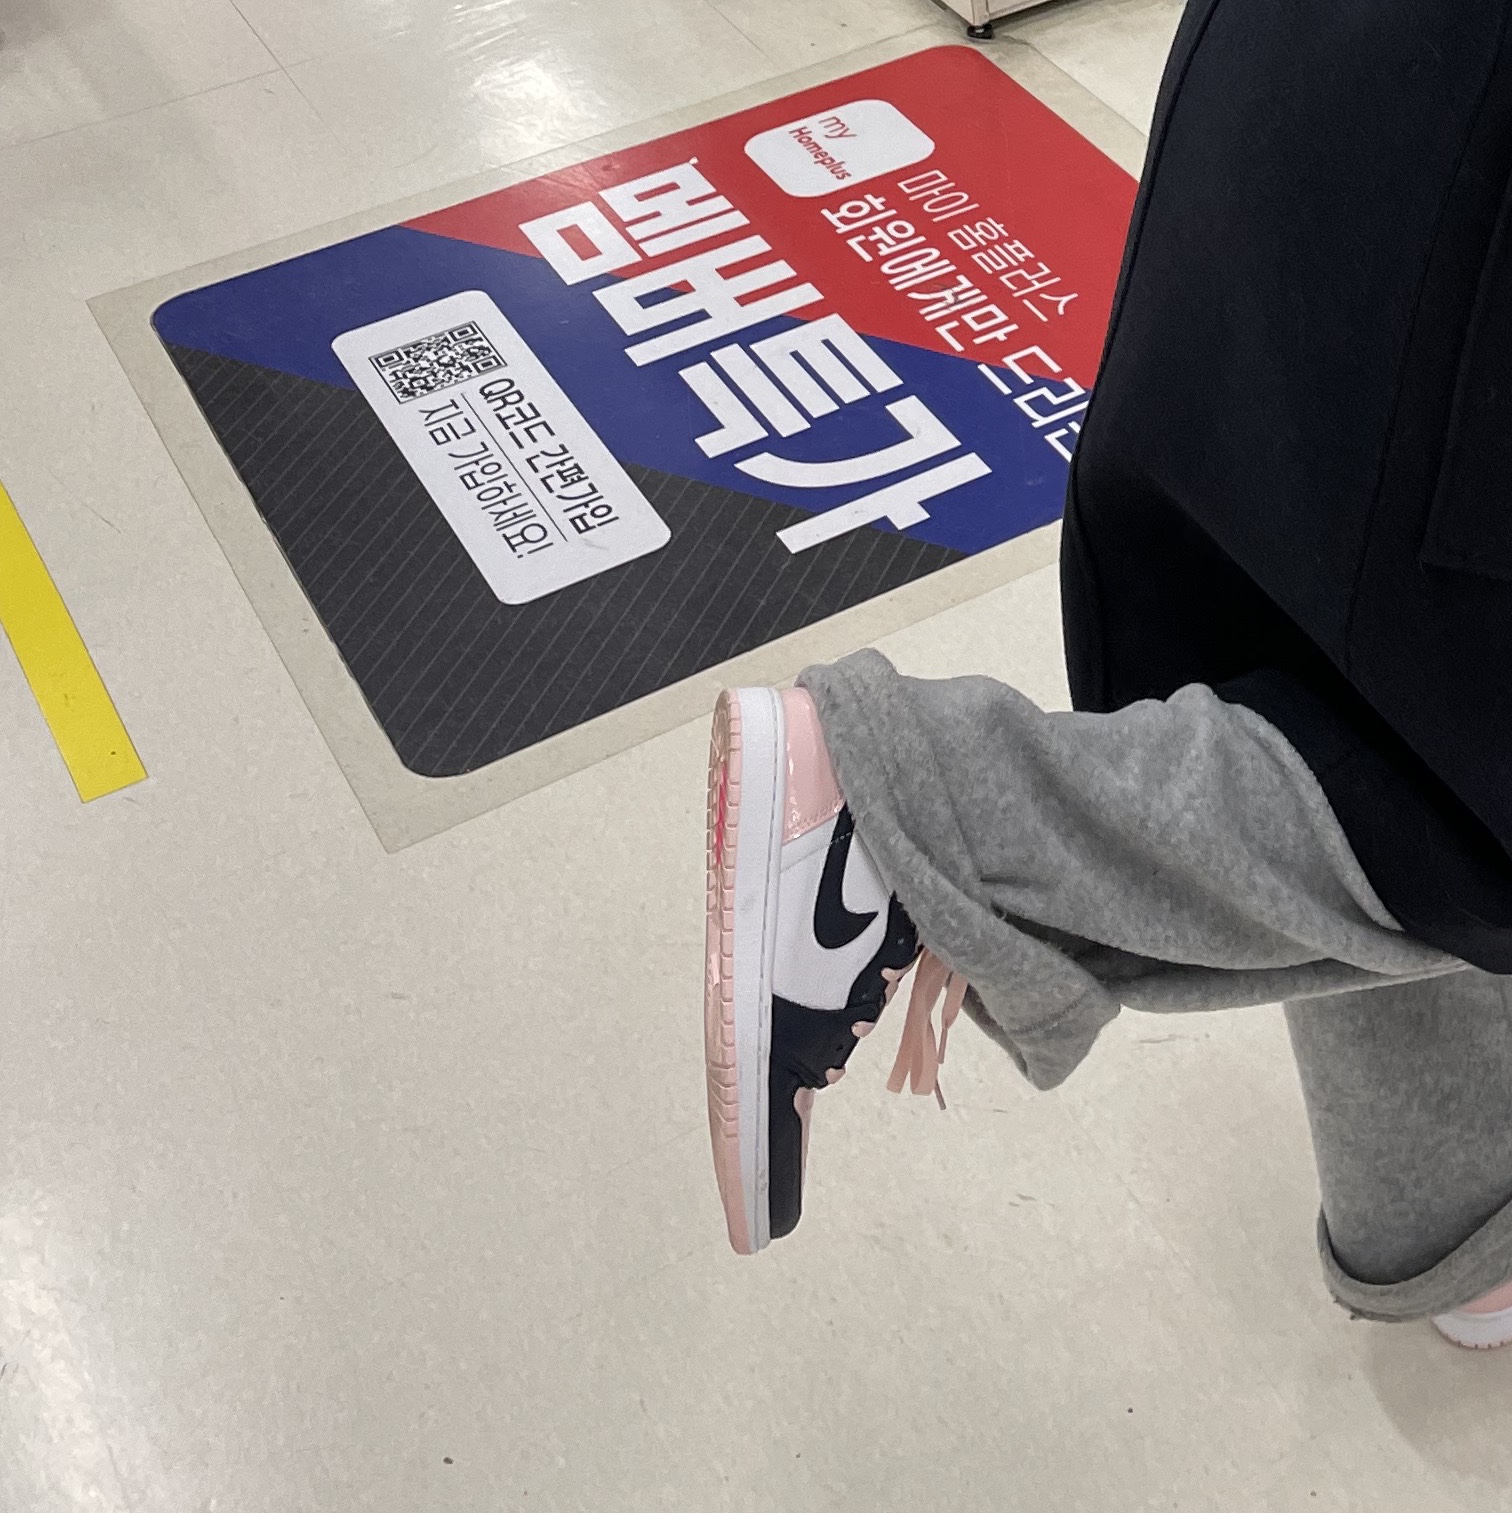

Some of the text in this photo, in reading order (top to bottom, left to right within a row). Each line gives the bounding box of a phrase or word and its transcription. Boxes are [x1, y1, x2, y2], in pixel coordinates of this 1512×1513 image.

[788, 125, 852, 181] Homeplus
[818, 115, 857, 140] my
[820, 193, 1019, 352] 회원에게만
[896, 169, 1079, 323] 마이 홈플러스
[518, 156, 993, 555] 멤버특가
[418, 398, 554, 559] 지금 가입하세요!
[478, 377, 620, 535] QR코드 간편가입
